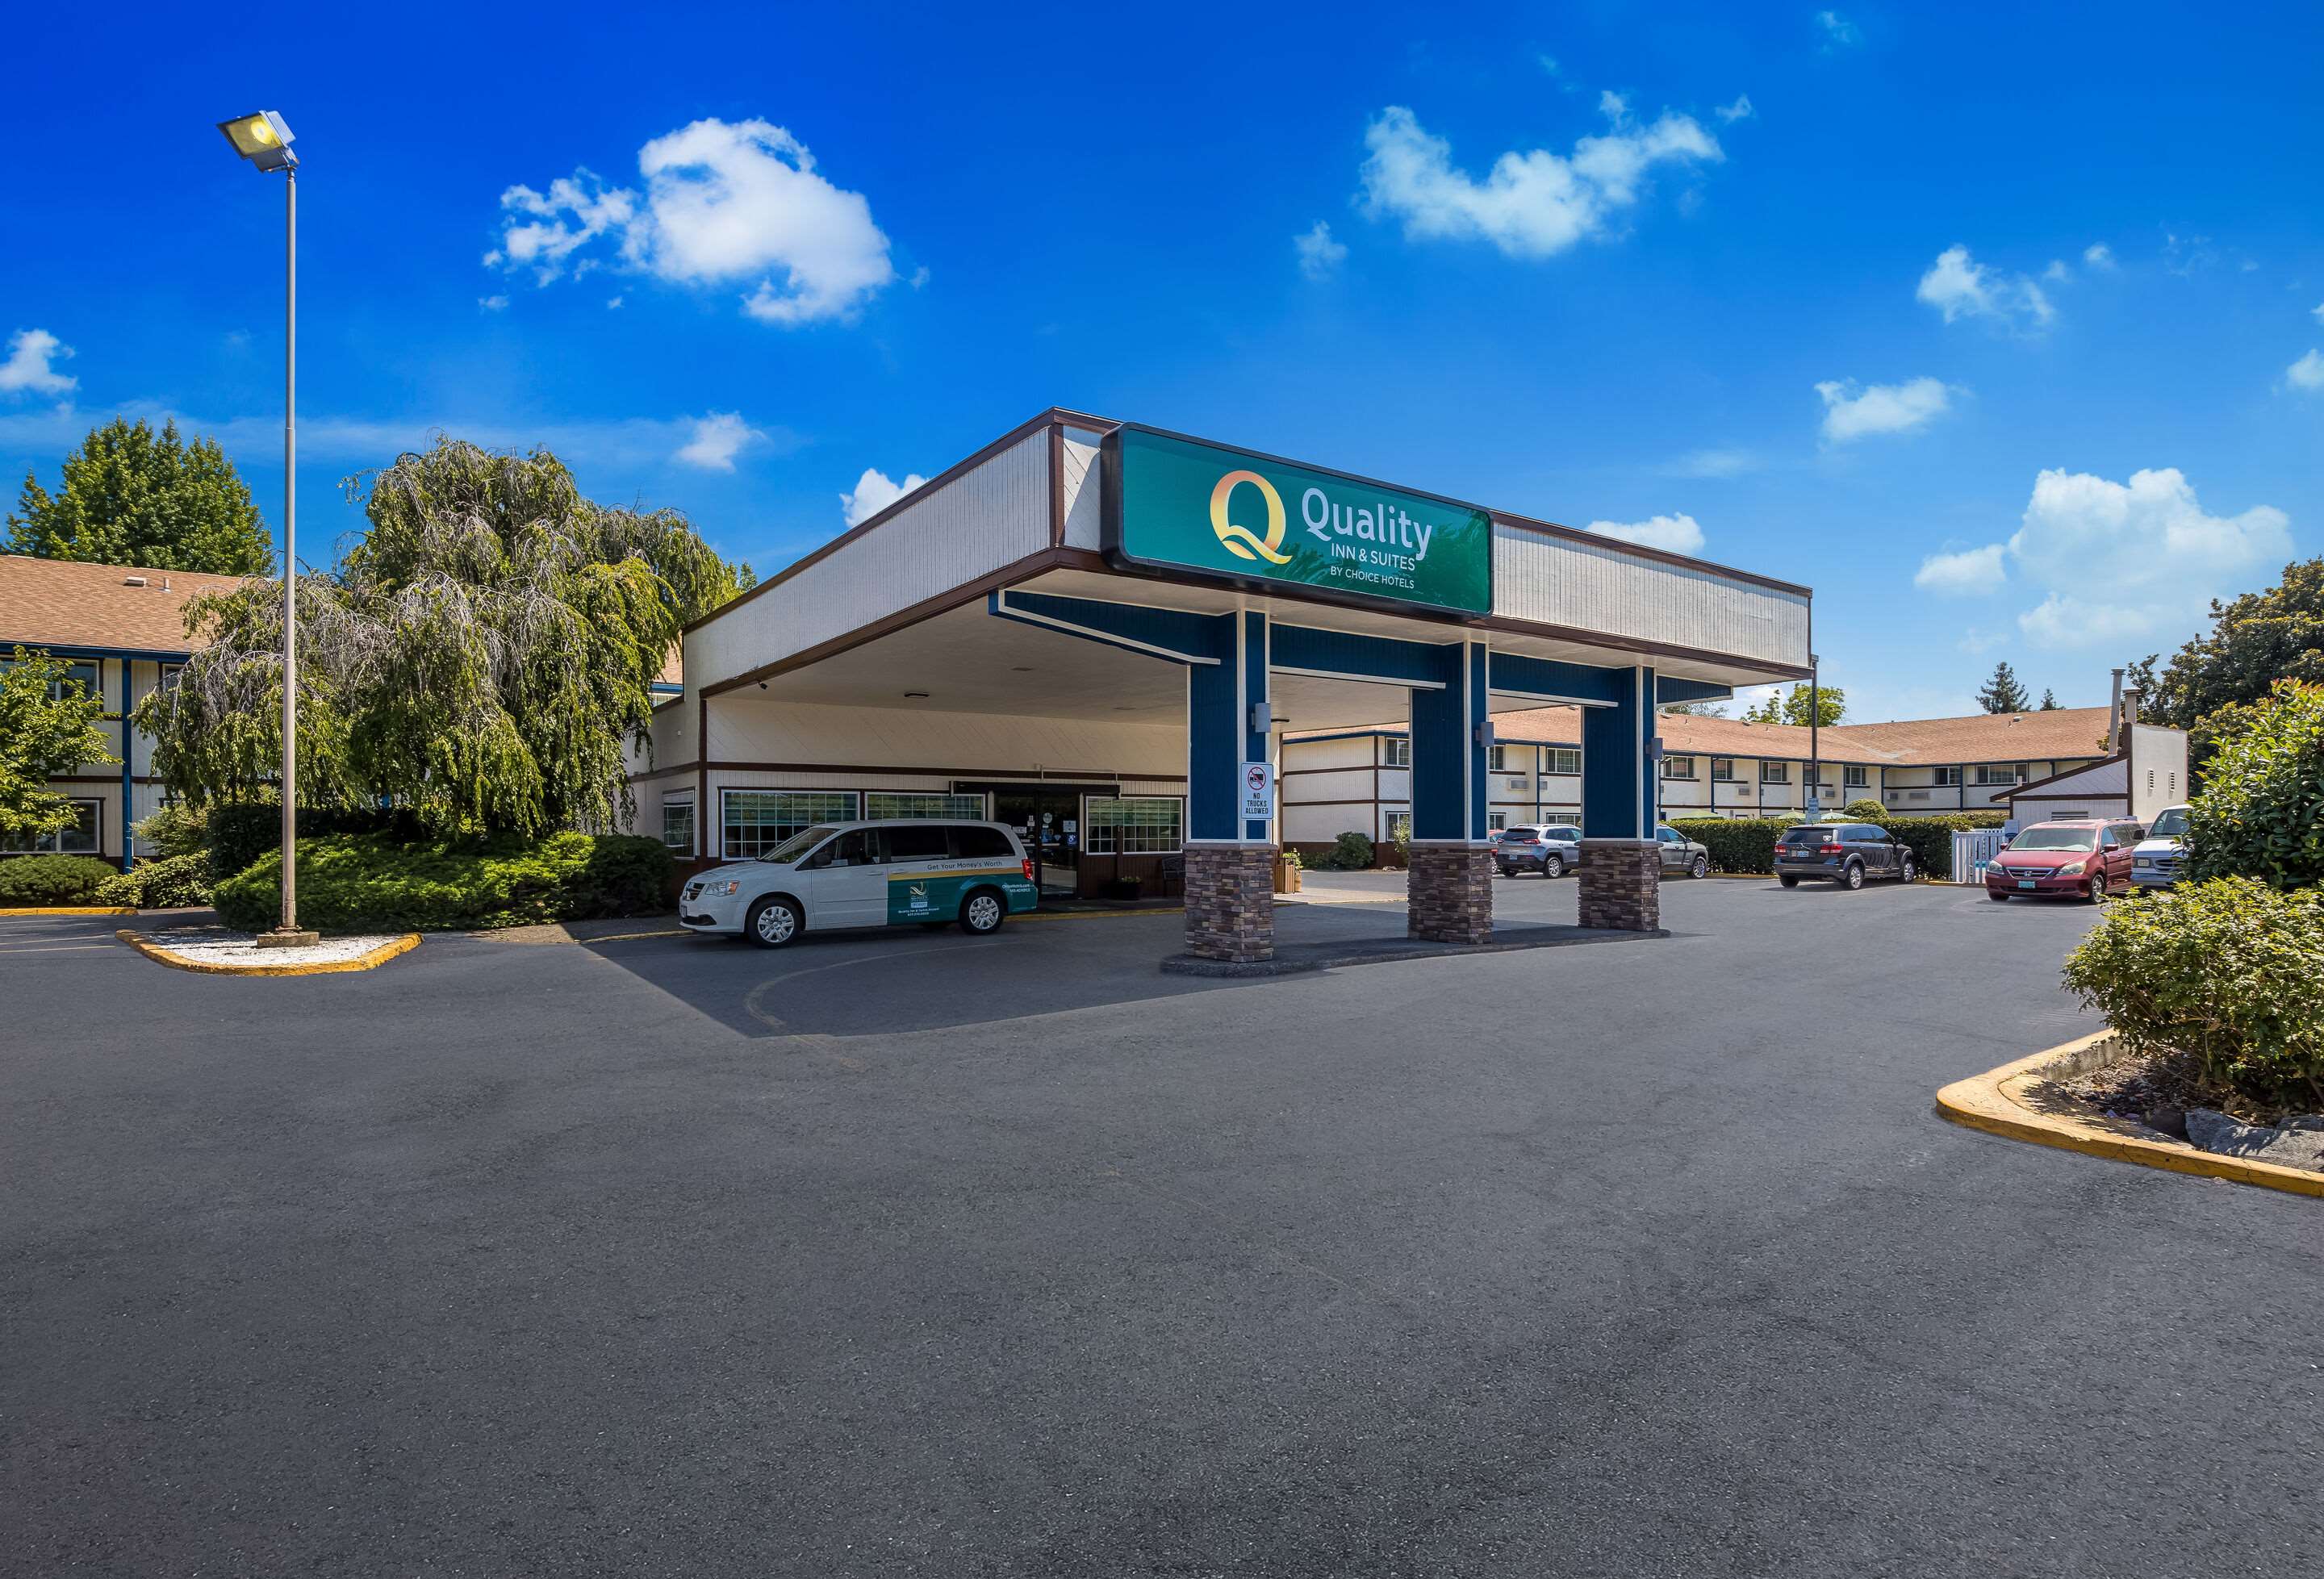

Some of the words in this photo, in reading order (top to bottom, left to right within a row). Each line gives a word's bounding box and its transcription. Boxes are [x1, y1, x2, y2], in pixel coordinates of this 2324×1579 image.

[1210, 470, 1293, 565] Q
[1302, 487, 1432, 561] Quality
[1331, 543, 1356, 560] INN
[1358, 548, 1367, 562] &
[1370, 550, 1415, 571] SUITES
[1331, 566, 1343, 576] BY
[1345, 568, 1379, 583] CHOICE
[1381, 574, 1415, 589] HOTELS
